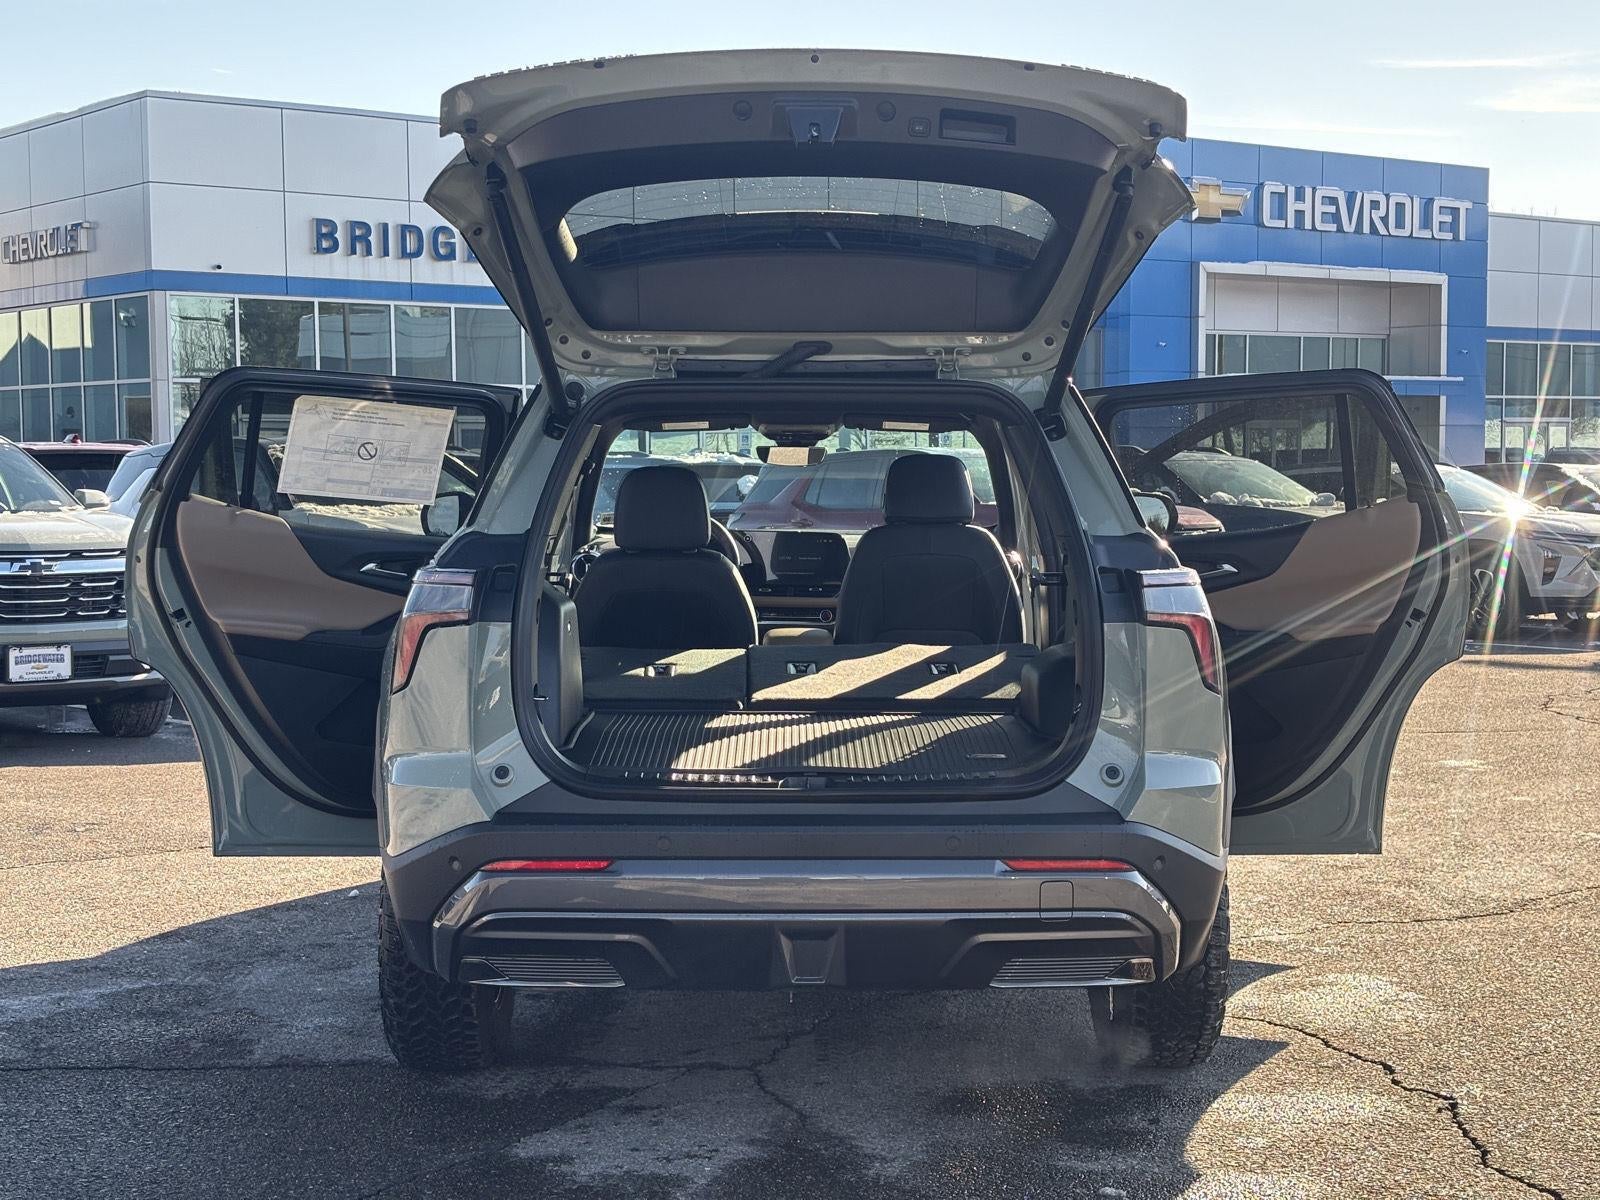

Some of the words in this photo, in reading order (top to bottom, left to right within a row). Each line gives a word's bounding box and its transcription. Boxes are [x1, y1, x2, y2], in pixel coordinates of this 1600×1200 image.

[1262, 182, 1472, 241] CHEVROLET
[1, 221, 93, 264] CHEVROLET
[15, 653, 65, 665] BRIDGEWATER
